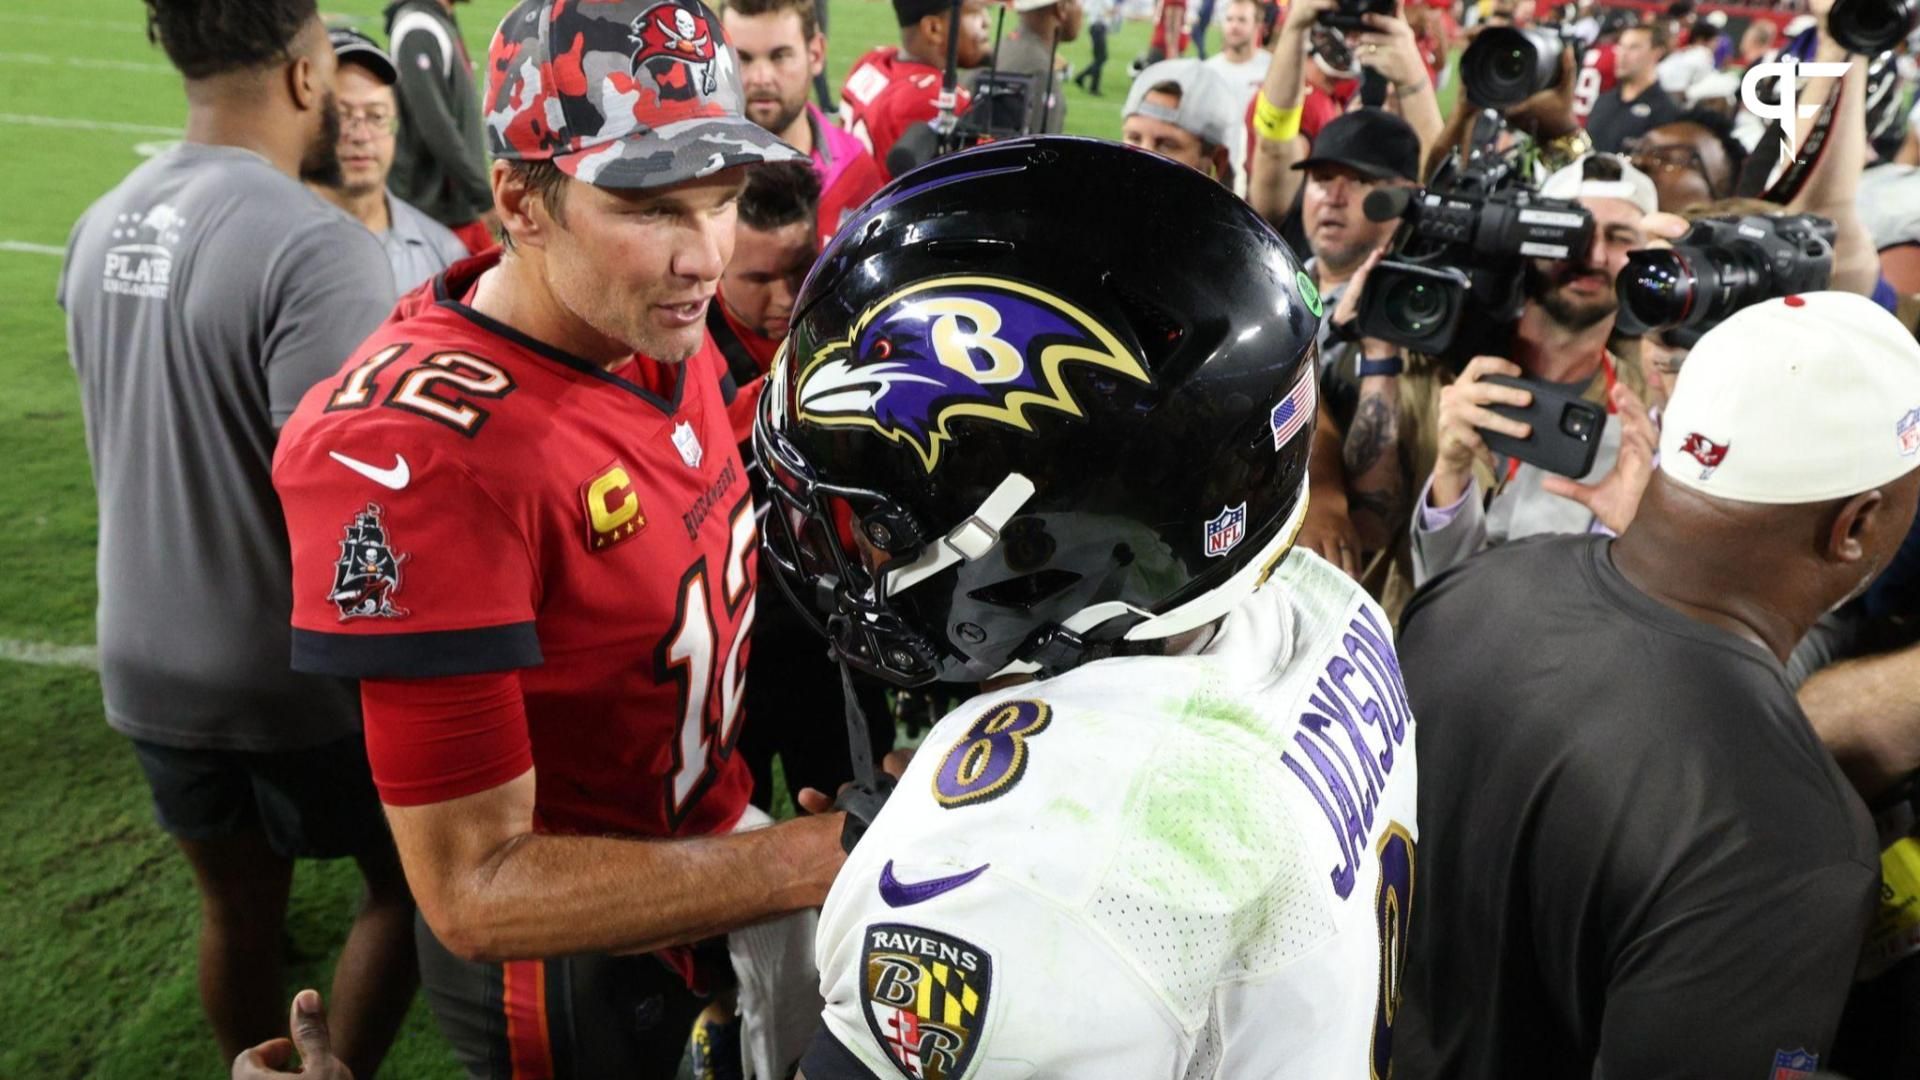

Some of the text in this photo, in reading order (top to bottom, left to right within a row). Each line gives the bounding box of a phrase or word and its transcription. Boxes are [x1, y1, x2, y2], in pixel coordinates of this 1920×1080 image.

[889, 297, 1024, 384] B
[323, 342, 518, 439] 12
[587, 466, 639, 533] C
[1210, 523, 1241, 552] NFL
[931, 699, 1053, 809] 8
[1280, 603, 1411, 901] JACKSON
[869, 955, 923, 1006] B
[871, 931, 979, 972] RAVENS
[917, 1023, 962, 1074] R
